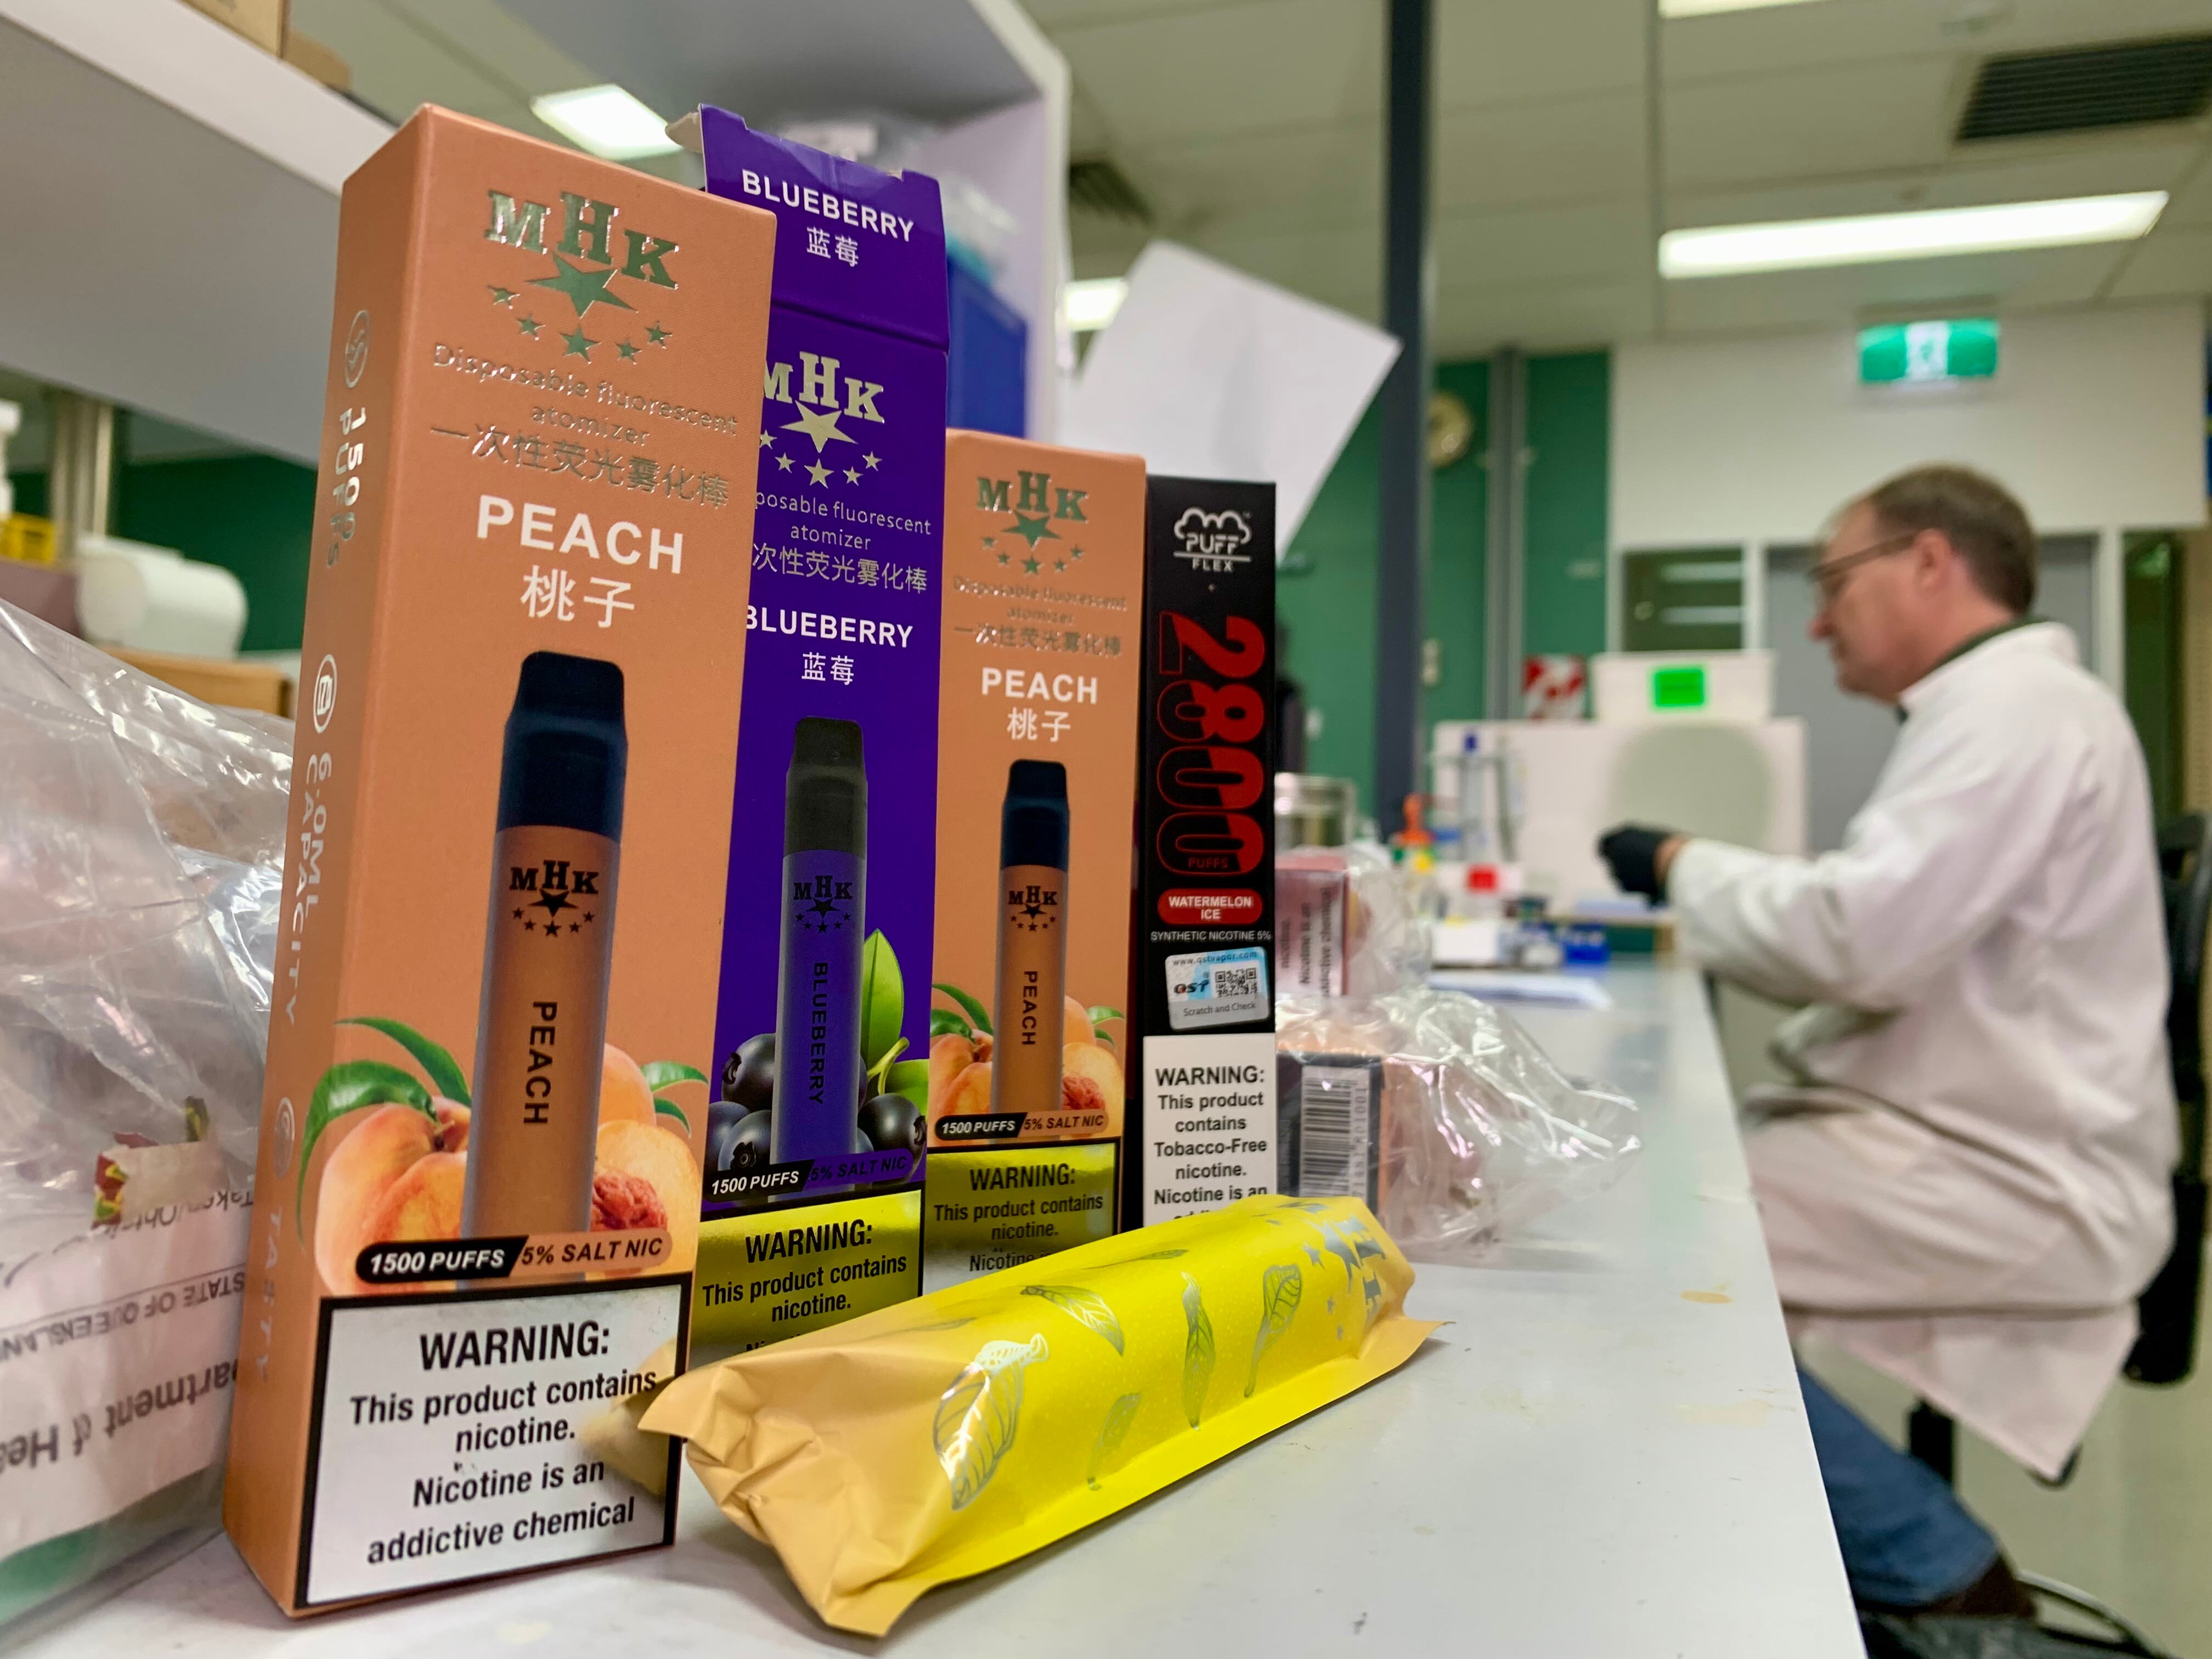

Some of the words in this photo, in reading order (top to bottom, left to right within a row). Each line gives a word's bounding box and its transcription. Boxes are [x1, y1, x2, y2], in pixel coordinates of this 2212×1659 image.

[742, 168, 914, 242] BLUEBERRY
[485, 189, 679, 290] MHK
[806, 226, 859, 267] 蓝莓
[433, 343, 590, 400] Disposable
[597, 379, 739, 437] fluorescent
[763, 351, 885, 425] MHK
[532, 404, 651, 448] atomizer
[342, 407, 367, 540] 1500
[431, 423, 729, 510] 一次性荧光雾化棒
[326, 408, 352, 569] PUFFS
[976, 470, 1089, 524] MHK
[477, 494, 684, 574] PEACH
[833, 501, 932, 535] fluorescent
[790, 523, 871, 551] atomizer
[1186, 532, 1239, 554] PUFF
[1192, 558, 1233, 572] FLEX
[520, 565, 636, 628] 桃子
[746, 605, 913, 648] BLUEBERRY
[801, 651, 855, 686] 蓝莓
[981, 667, 1098, 704] PEACH
[1007, 706, 1071, 743] 桃子
[1157, 610, 1265, 875] 2800
[509, 859, 599, 895] MHK
[1188, 857, 1228, 869] PUFFS
[286, 753, 317, 1025] CAPACITY
[793, 874, 853, 901] MHK
[1008, 885, 1057, 905] MHK
[1169, 896, 1252, 908] WATERMELON
[1201, 909, 1221, 920] ICE
[1150, 931, 1206, 941] SYNTHETIC
[1209, 931, 1255, 940] NICOTINE
[1257, 930, 1272, 940] 5%
[1022, 970, 1038, 1045] PEACH
[1183, 1003, 1212, 1017] Scratch
[1215, 1003, 1230, 1013] and
[1232, 1001, 1256, 1012] Check
[809, 961, 829, 1104] BLUEBERRY
[523, 1001, 558, 1124] PEACH
[1155, 1065, 1265, 1086] WARNING:
[1158, 1094, 1193, 1110] This
[1199, 1091, 1264, 1111] product
[941, 1122, 972, 1134] 1500
[973, 1120, 1015, 1132] PUFFS
[1024, 1118, 1042, 1130] 5%
[1046, 1116, 1079, 1129] SALT
[1081, 1115, 1104, 1126] NIC
[1175, 1116, 1246, 1132] contains
[1154, 1138, 1267, 1157] Tobacco-Free
[712, 1177, 747, 1195] 1500
[749, 1170, 799, 1189] PUFFS
[810, 1166, 833, 1182] 5%
[837, 1160, 878, 1178] SALT
[881, 1156, 907, 1172] NIC
[970, 1163, 1075, 1190] WARNING:
[1175, 1162, 1247, 1180] nicotine.
[934, 1204, 968, 1221] This
[974, 1199, 1035, 1222] product
[1041, 1194, 1103, 1214] contains
[1154, 1187, 1223, 1204] Nicotine
[1229, 1185, 1242, 1199] is
[745, 1219, 872, 1263] WARNING:
[991, 1222, 1059, 1240] nicotine.
[370, 1252, 423, 1274] 1500
[428, 1249, 505, 1271] PUFFS
[521, 1244, 555, 1265] 5%
[562, 1240, 620, 1263] SALT
[624, 1238, 663, 1259] NIC
[184, 1272, 245, 1306] STATE
[702, 1282, 743, 1306] This
[750, 1267, 823, 1303] product
[830, 1255, 907, 1284] contains
[144, 1291, 176, 1318] OF
[771, 1294, 851, 1323] nicotine.
[419, 1319, 610, 1371] WARNING:
[350, 1393, 414, 1425] This
[423, 1381, 537, 1425] product
[546, 1369, 657, 1404] contains
[455, 1418, 576, 1453] nicotine.
[413, 1468, 532, 1508] Nicotine
[541, 1464, 564, 1491] is
[572, 1461, 605, 1486] an
[366, 1522, 504, 1565] addictive
[513, 1497, 635, 1541] chemical
